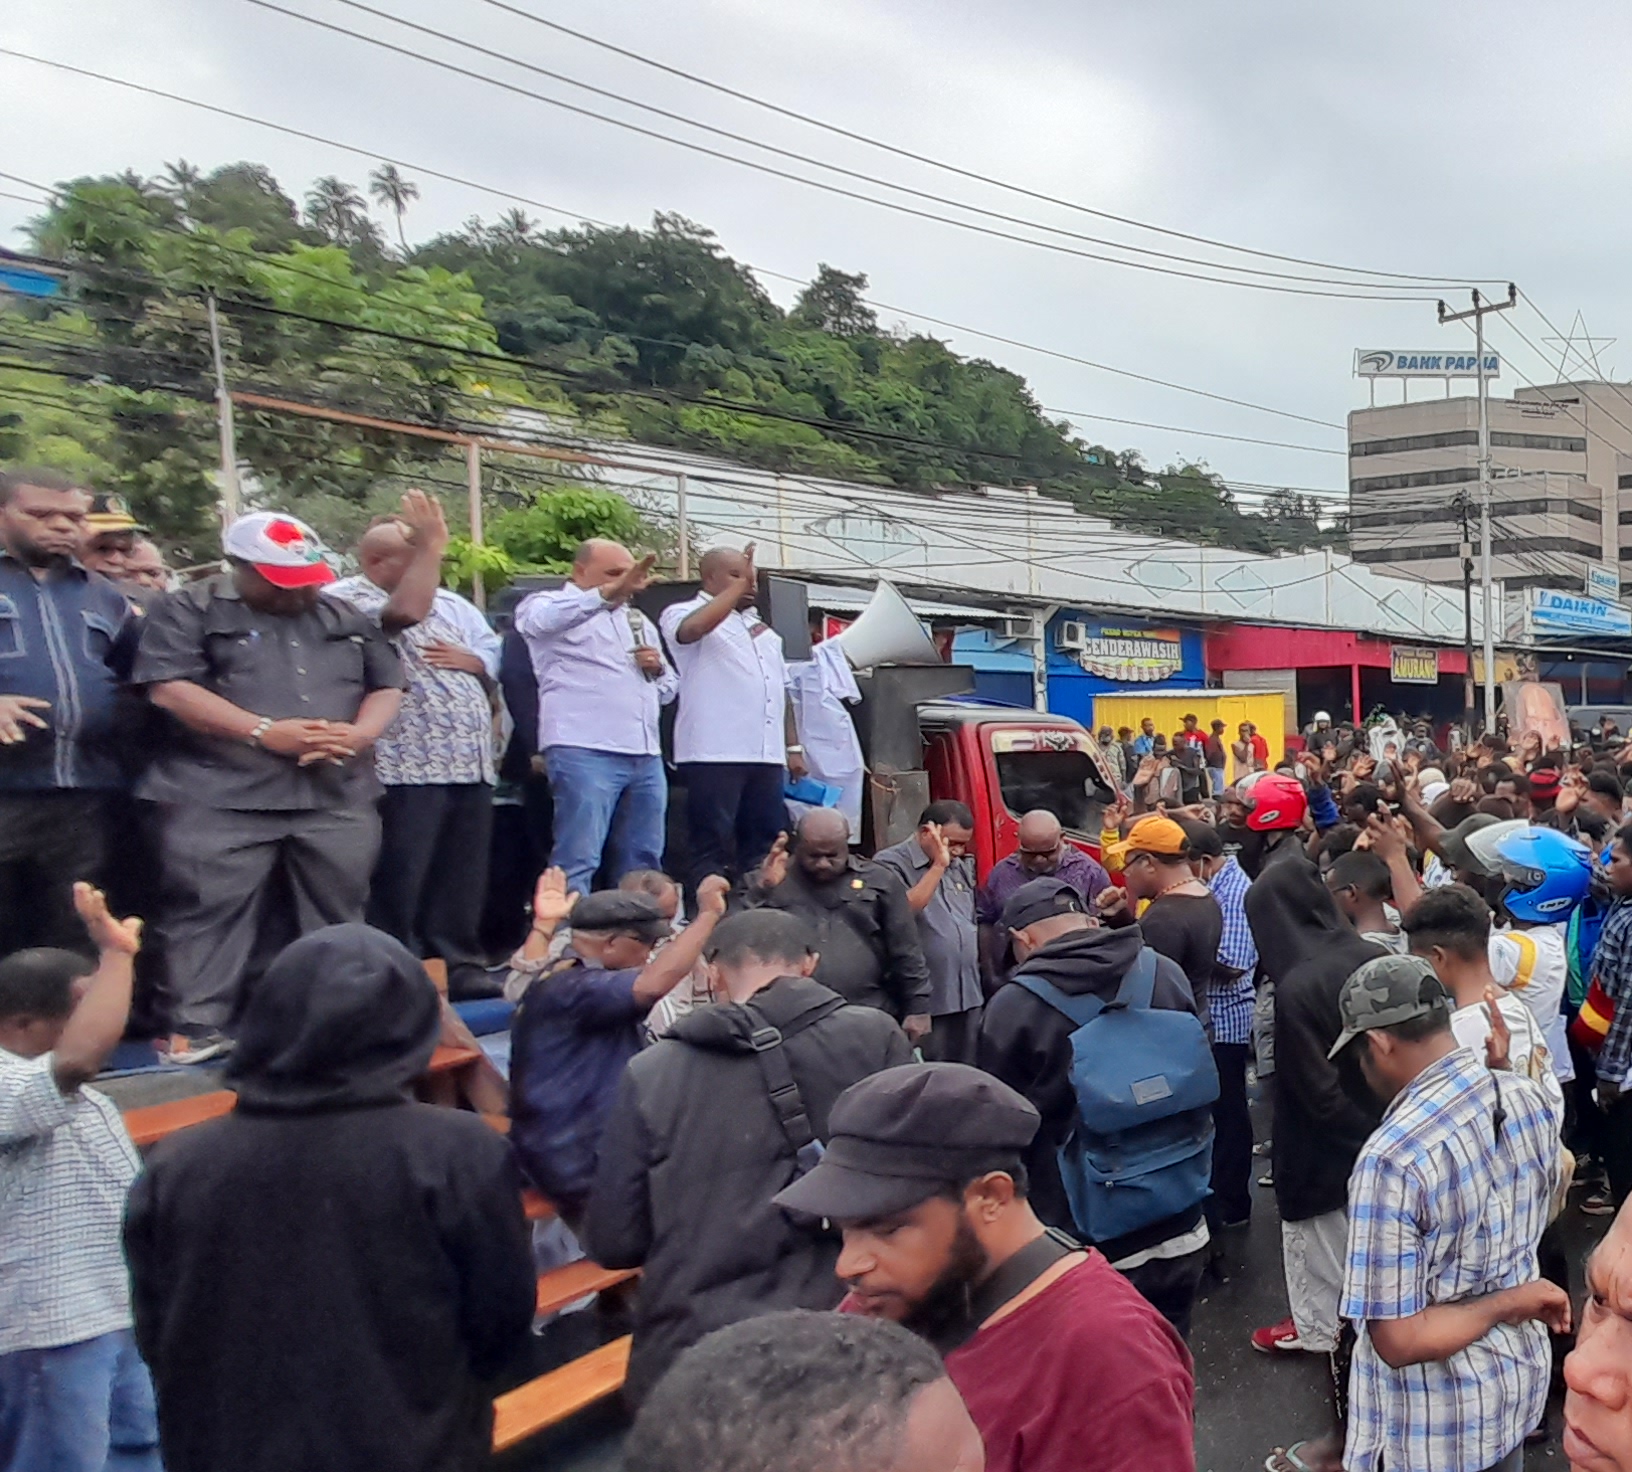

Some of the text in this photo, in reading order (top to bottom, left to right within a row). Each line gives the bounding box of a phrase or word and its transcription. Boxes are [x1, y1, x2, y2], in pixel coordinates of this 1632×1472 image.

[1397, 356, 1441, 370] BANK
[1551, 595, 1607, 617] DAIKIN
[1084, 637, 1179, 659] CENDERAWASIH
